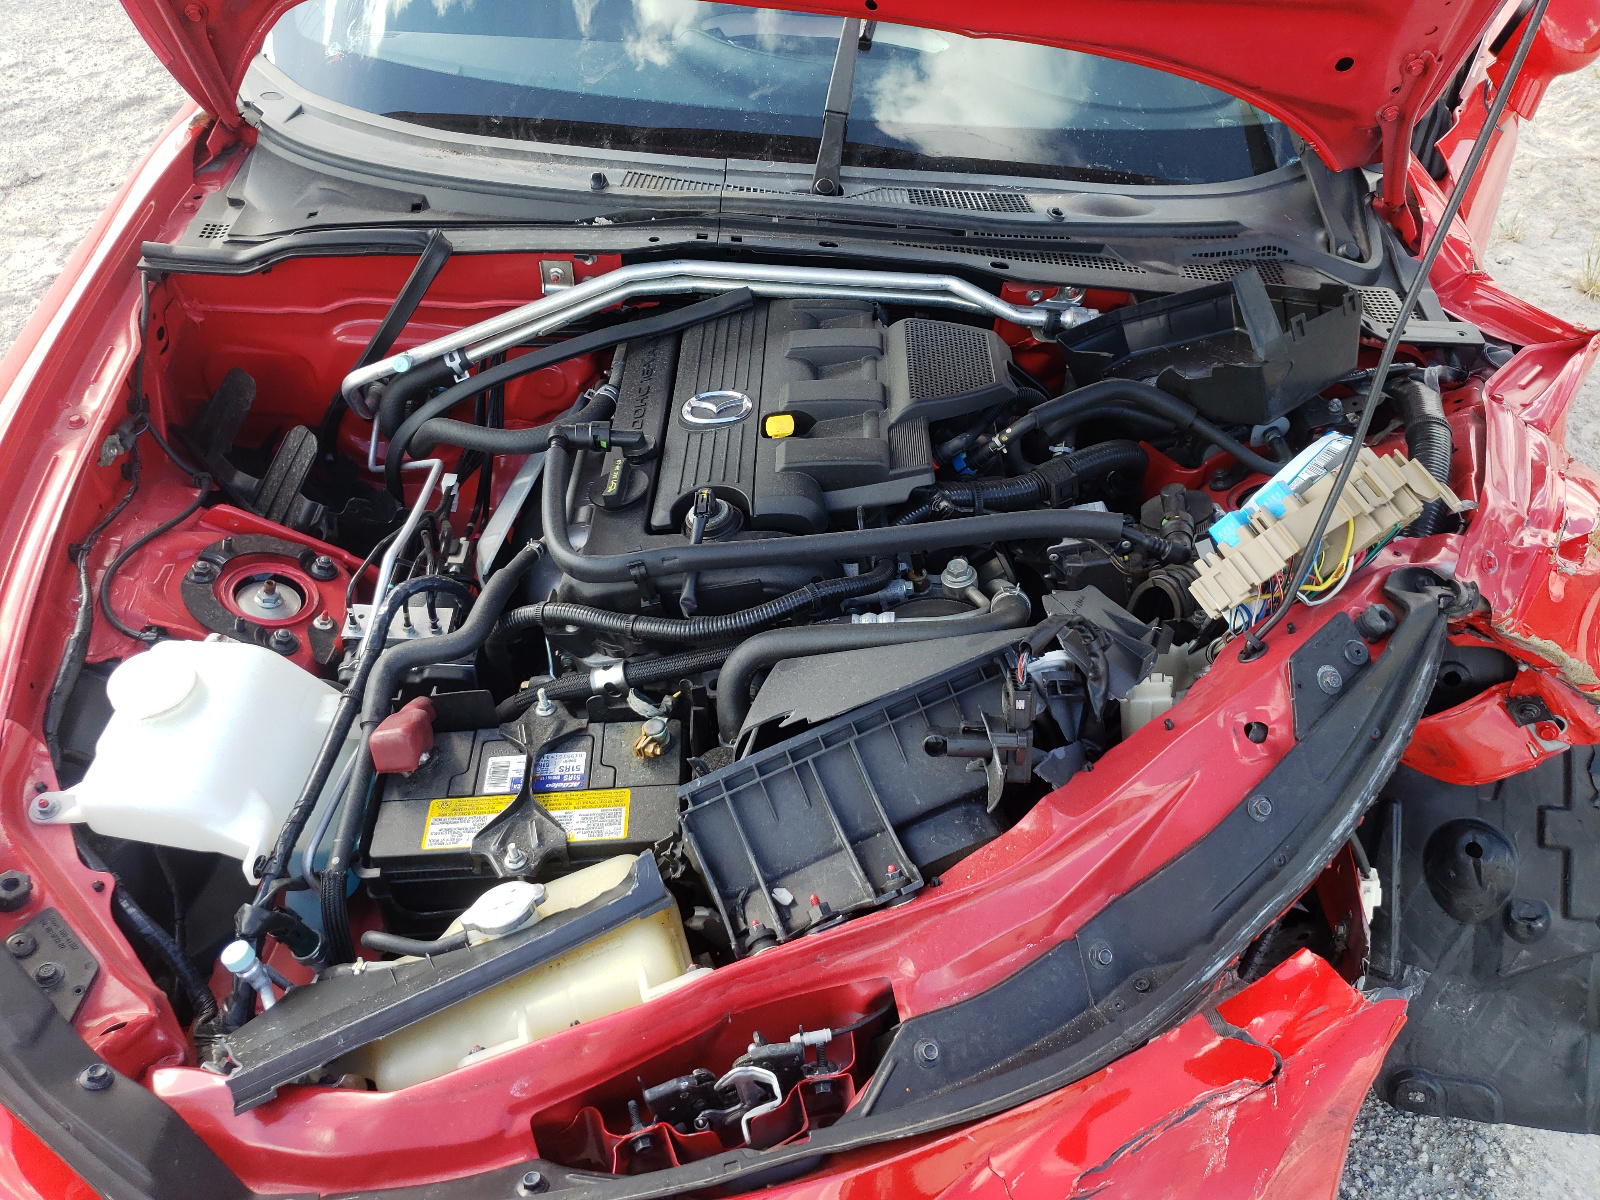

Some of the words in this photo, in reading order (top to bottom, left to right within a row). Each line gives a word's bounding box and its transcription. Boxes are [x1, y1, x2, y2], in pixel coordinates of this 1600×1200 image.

[631, 385, 652, 430] DOHC
[558, 764, 581, 773] 51RS
[545, 781, 580, 789] ACDelco
